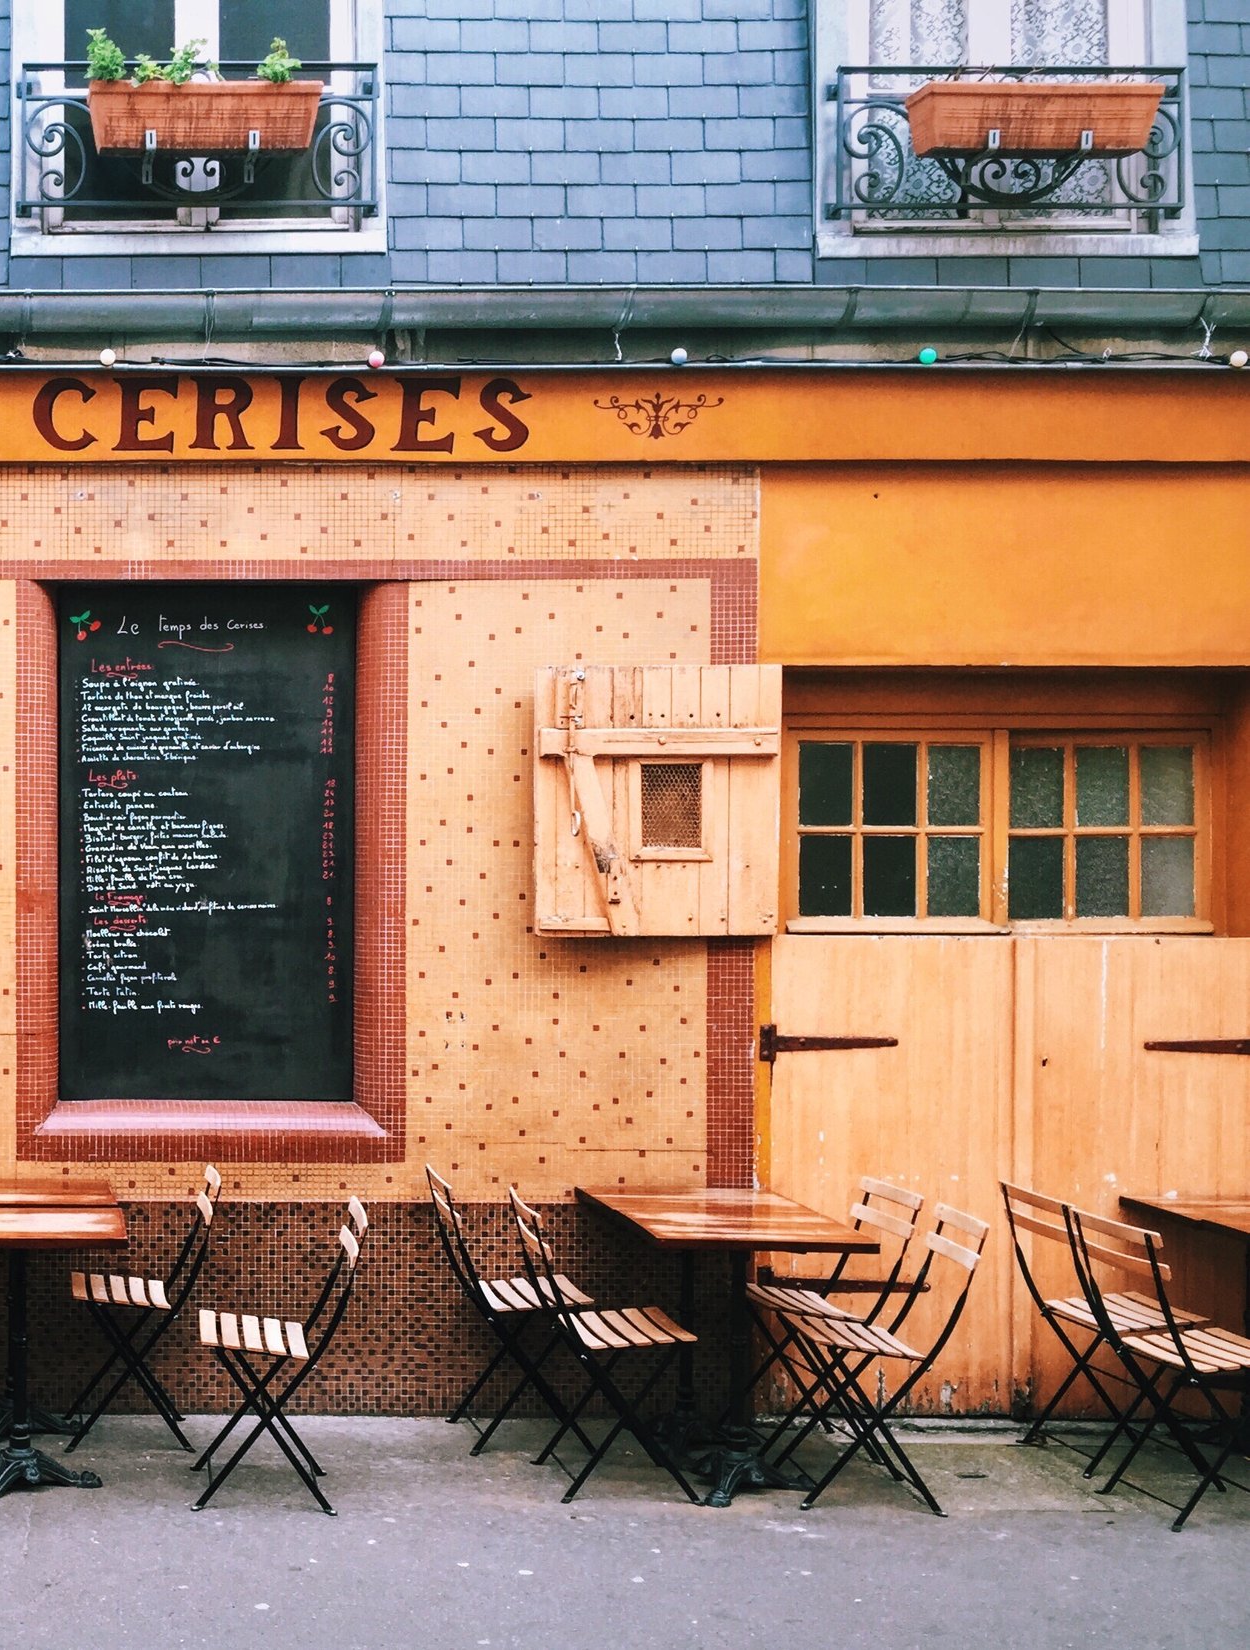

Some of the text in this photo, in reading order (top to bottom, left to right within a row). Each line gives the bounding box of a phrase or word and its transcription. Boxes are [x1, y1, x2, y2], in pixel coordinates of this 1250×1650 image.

[32, 377, 533, 455] CERISES
[116, 616, 140, 635] Le
[199, 616, 219, 631] des
[82, 678, 111, 693] Soupe
[89, 769, 107, 782] Les
